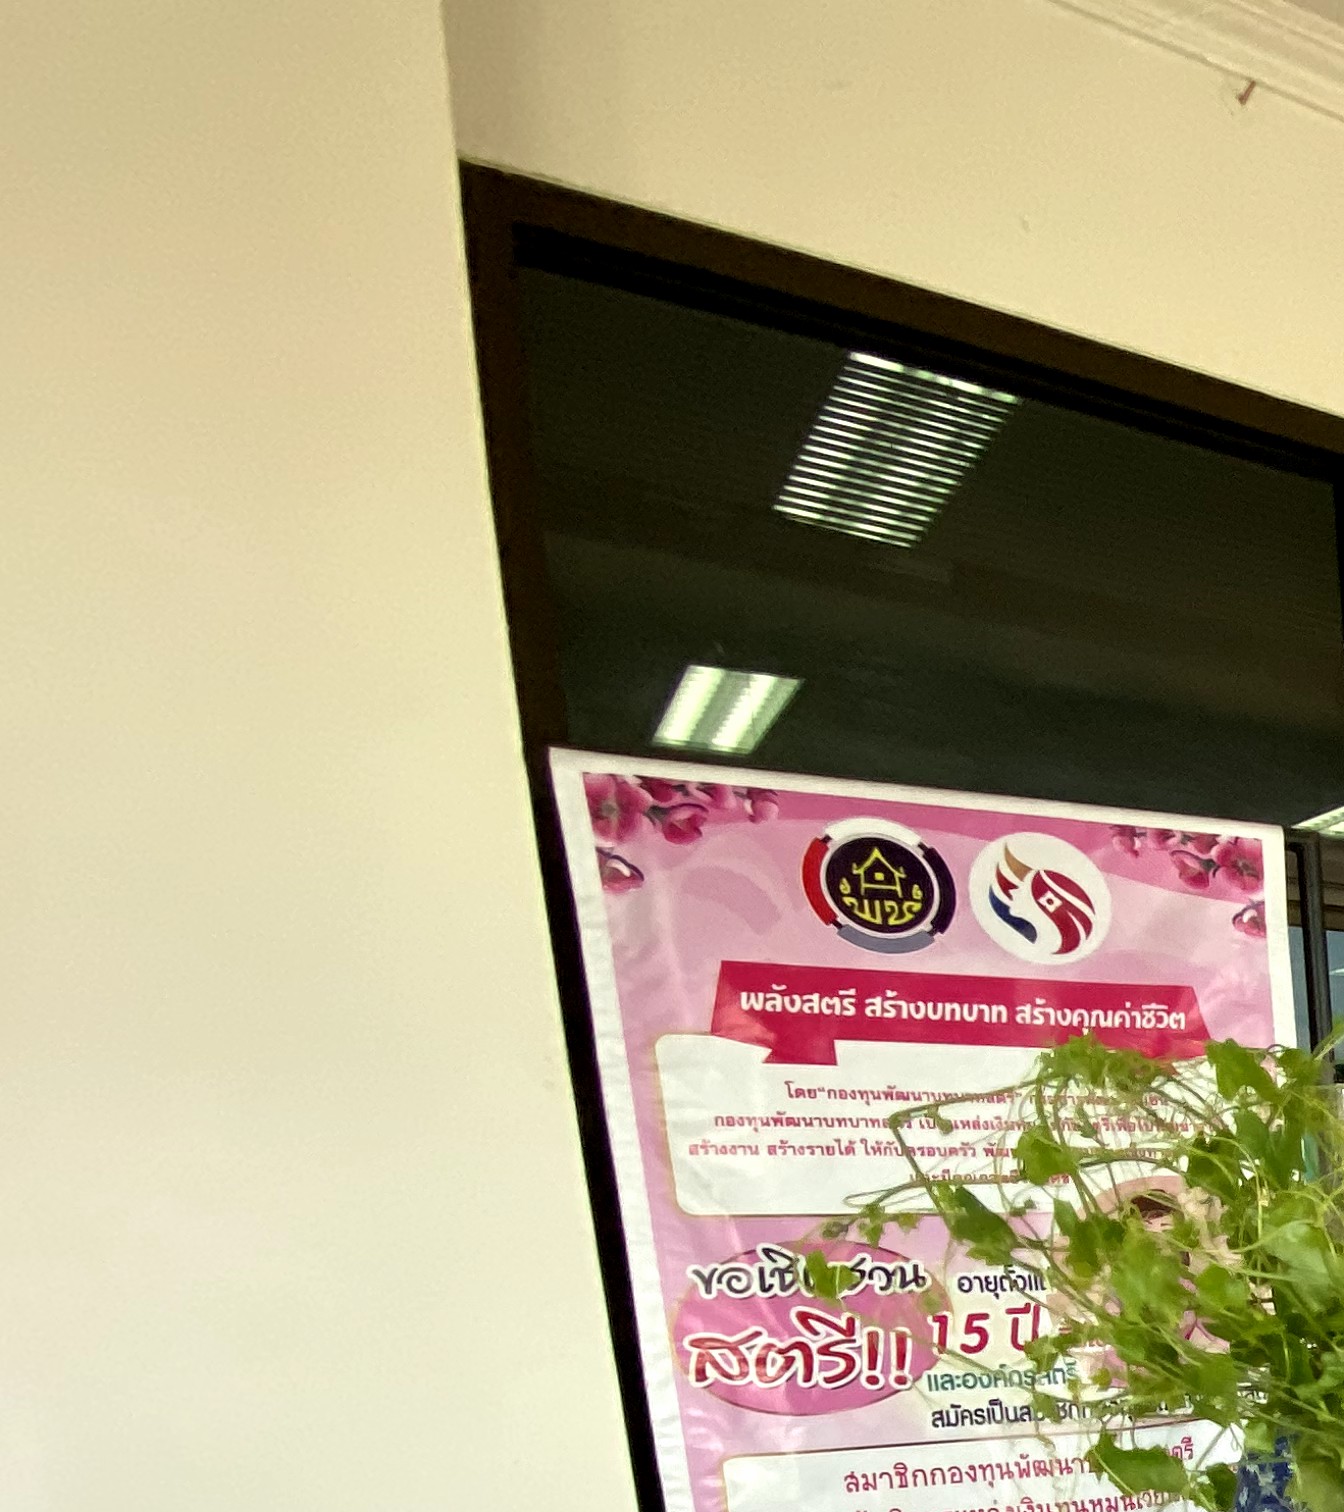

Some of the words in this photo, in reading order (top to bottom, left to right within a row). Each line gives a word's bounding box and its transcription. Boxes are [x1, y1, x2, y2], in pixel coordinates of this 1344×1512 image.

[740, 984, 857, 1017] พลังสตรี
[865, 989, 1007, 1022] สร้างบทบาท
[1016, 998, 1186, 1034] สร้างคุณค่าชีวิต
[767, 1138, 856, 1157] สร้างรายได้
[688, 1310, 908, 1386] สตรี!!
[932, 1312, 991, 1355] 15
[1005, 1302, 1041, 1351] ปี
